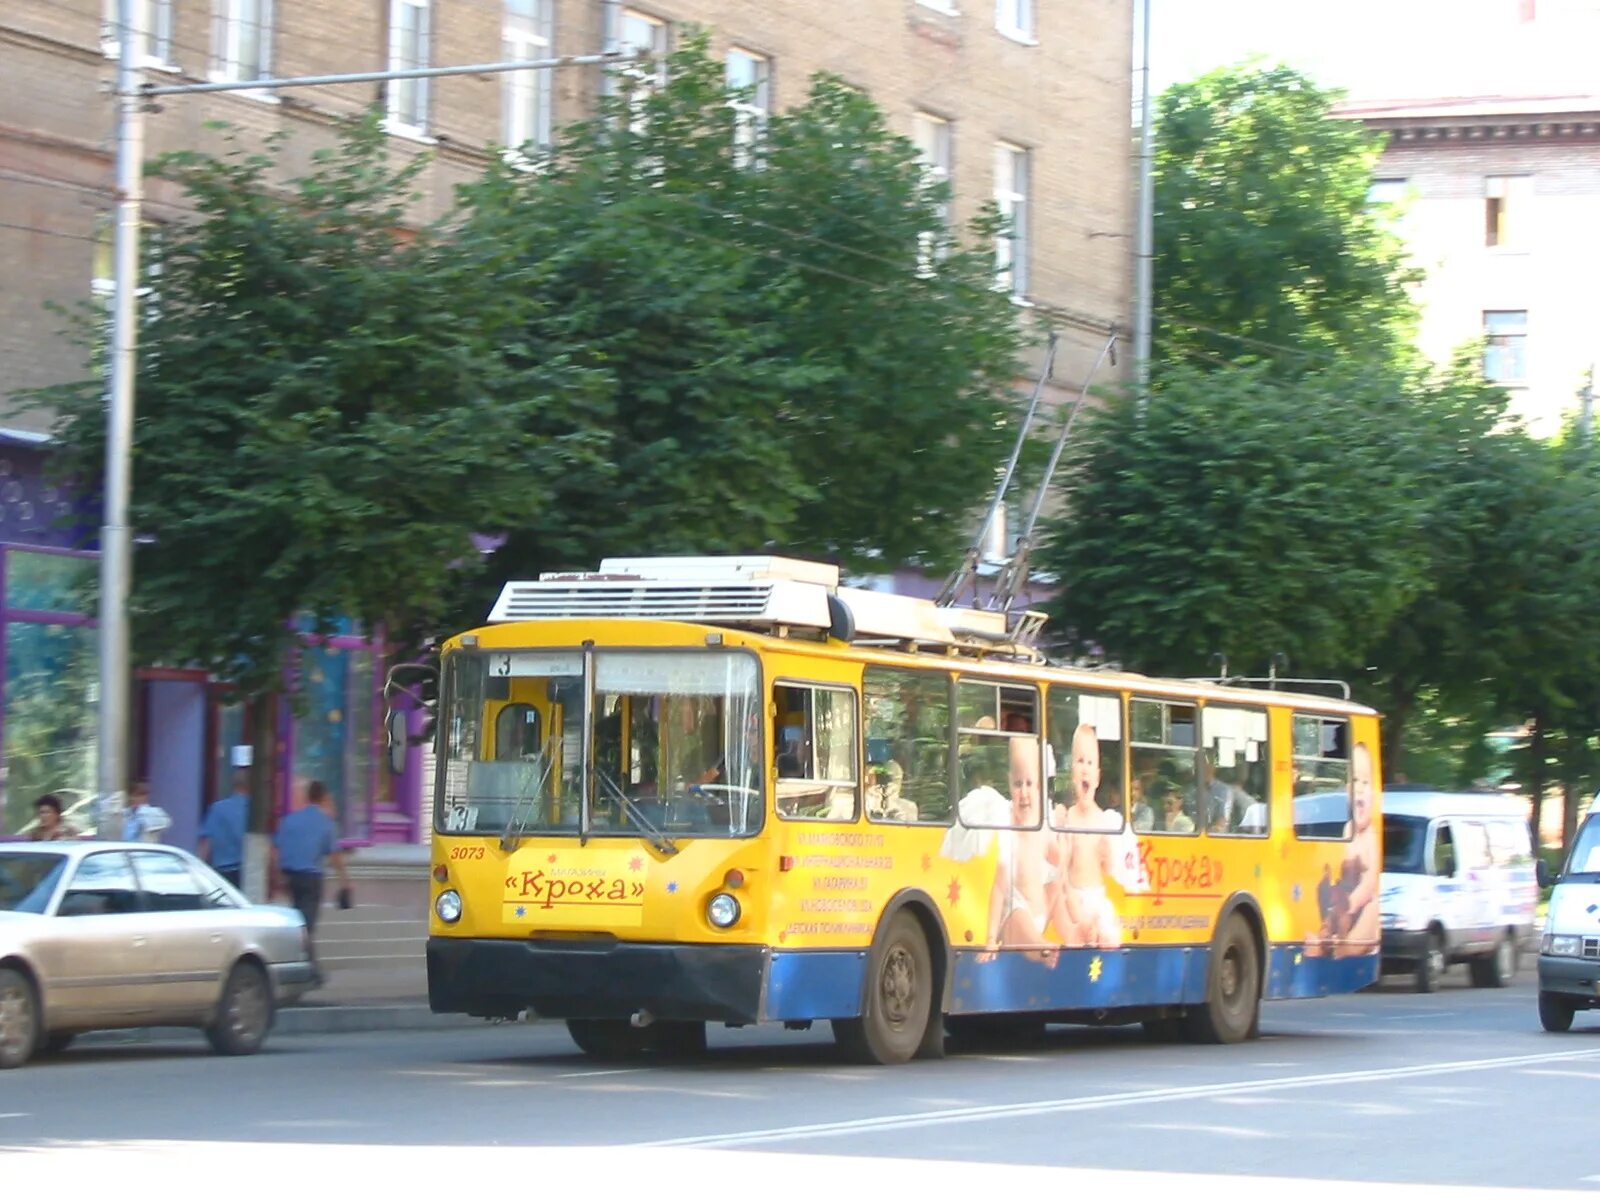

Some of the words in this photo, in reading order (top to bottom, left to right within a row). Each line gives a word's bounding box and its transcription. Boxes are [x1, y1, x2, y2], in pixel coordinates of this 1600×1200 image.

[498, 653, 511, 676] 3
[450, 847, 485, 860] 3073
[505, 870, 644, 909] «Кроха»
